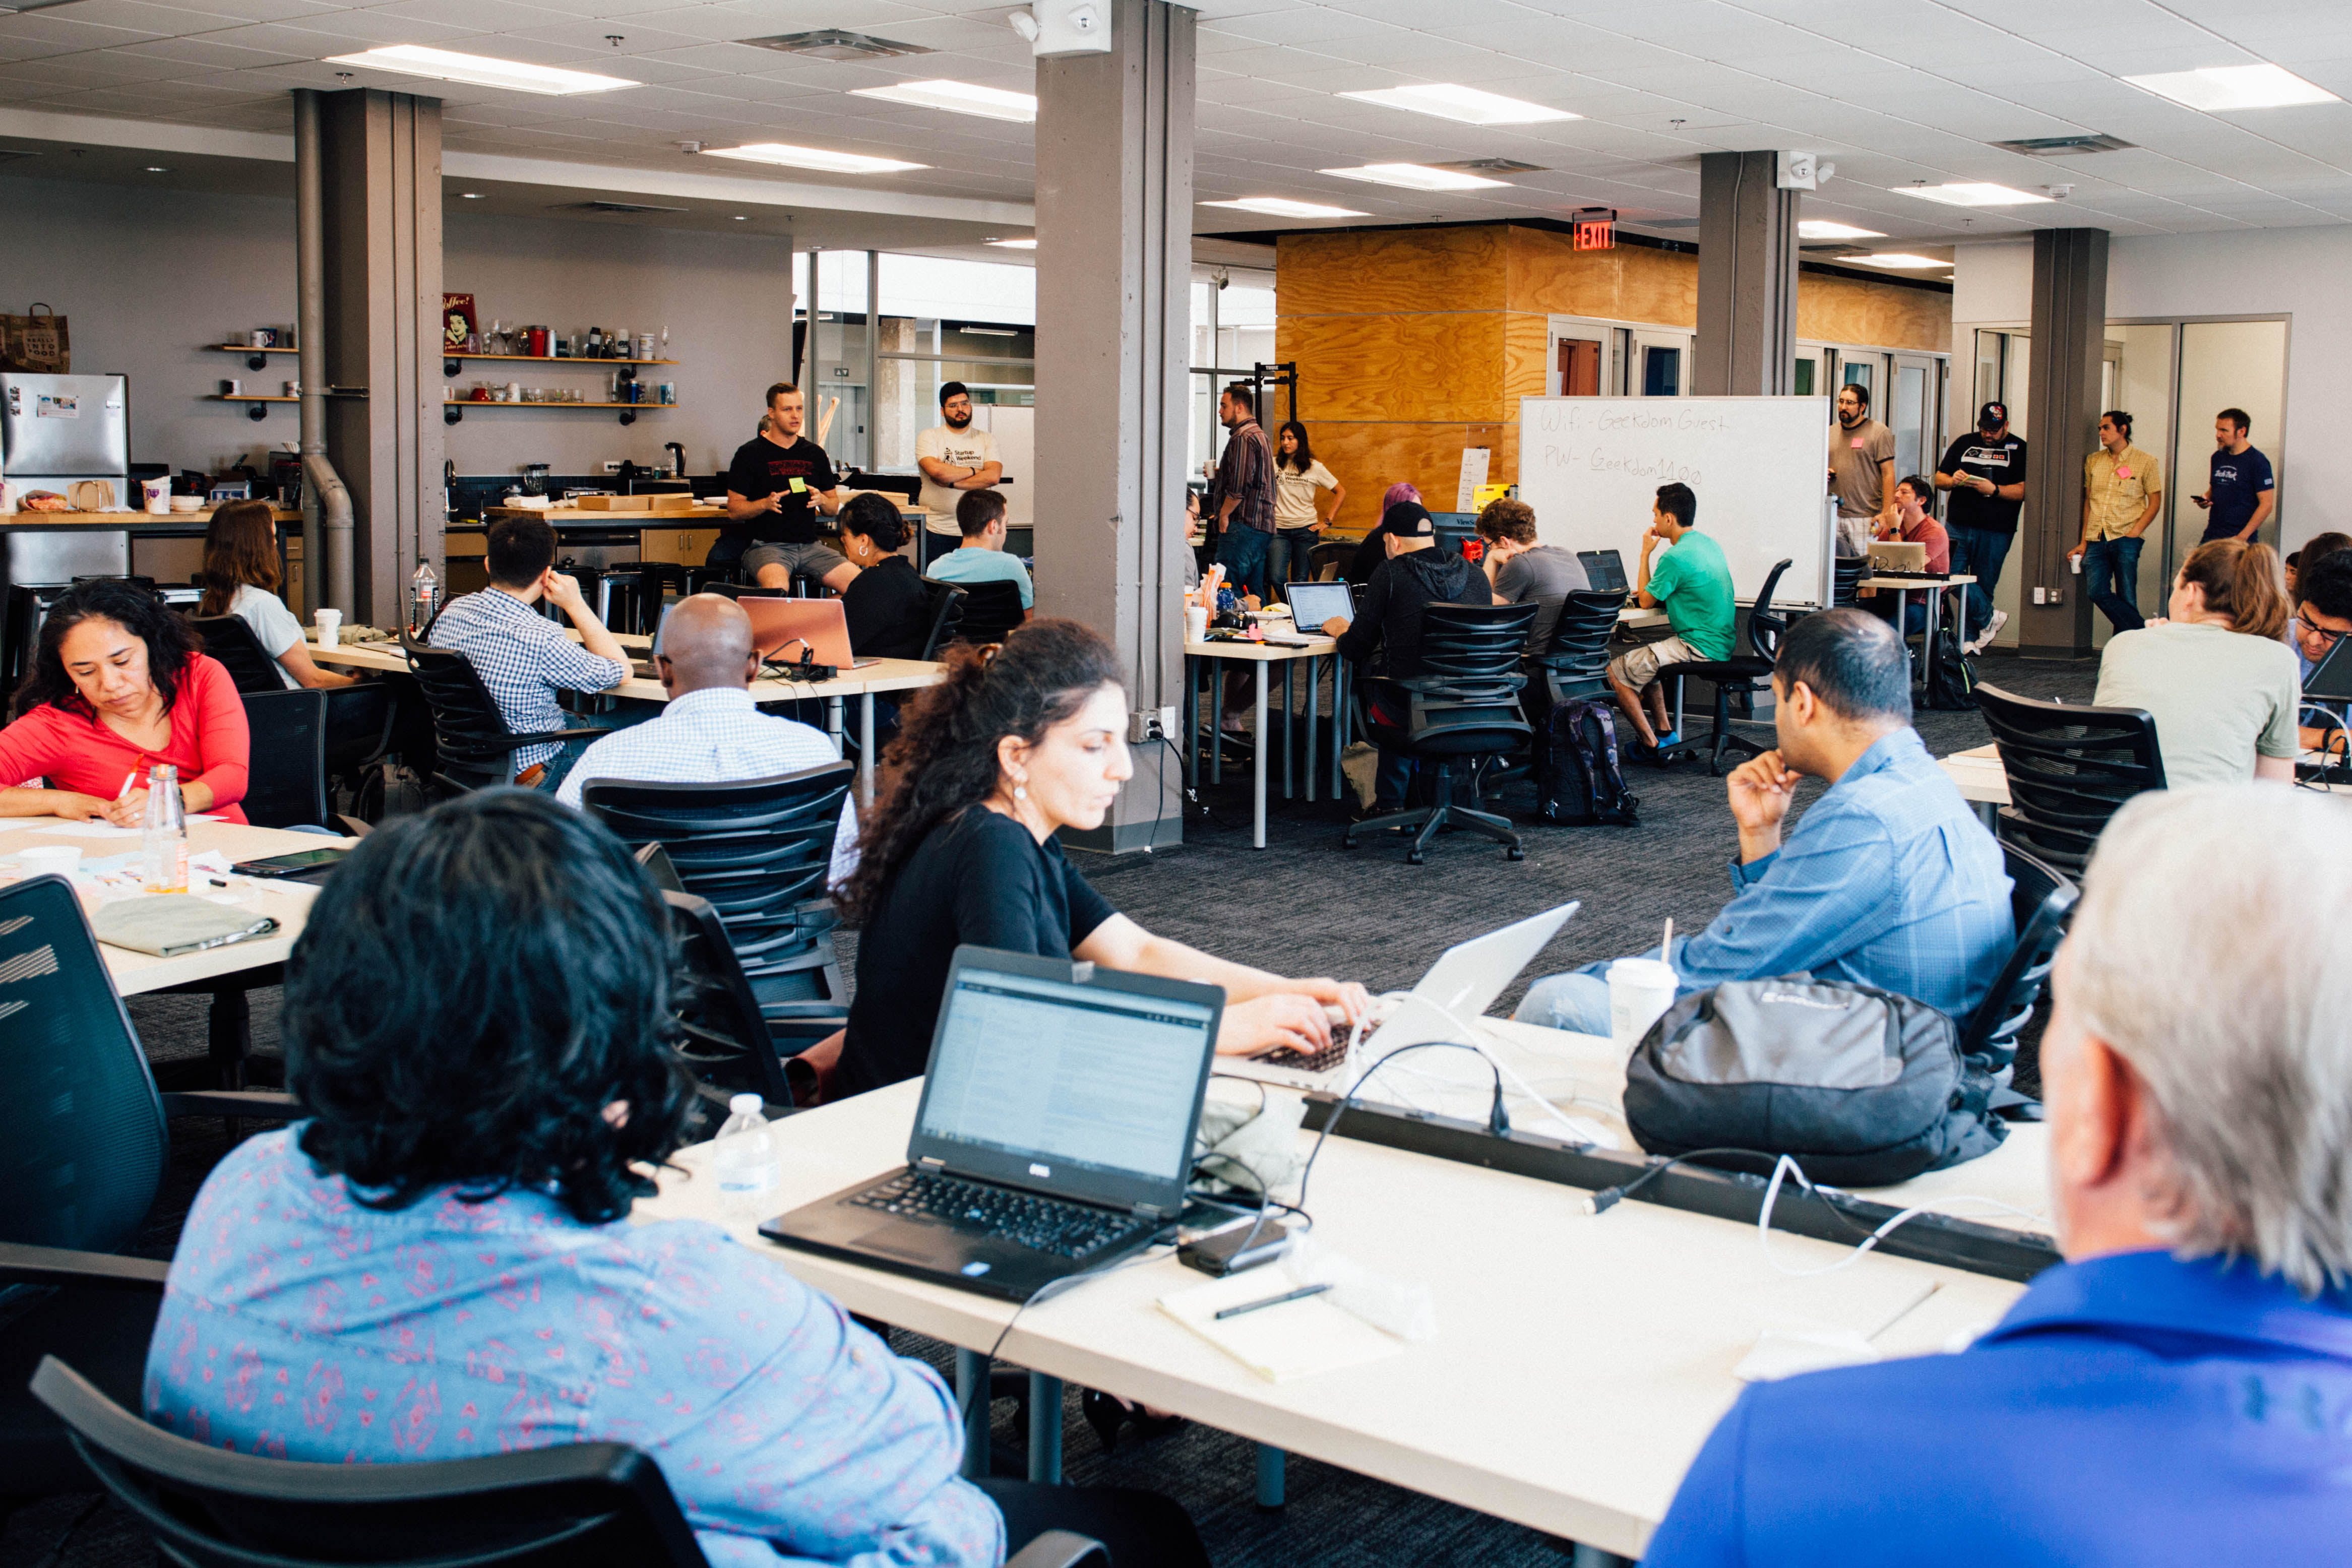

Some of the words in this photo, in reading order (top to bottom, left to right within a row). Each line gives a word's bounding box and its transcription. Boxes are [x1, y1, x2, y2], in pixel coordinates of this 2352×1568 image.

[1581, 221, 1611, 249] EXIT
[1541, 405, 1580, 431] Wifi
[1598, 410, 1672, 430] Geekdom
